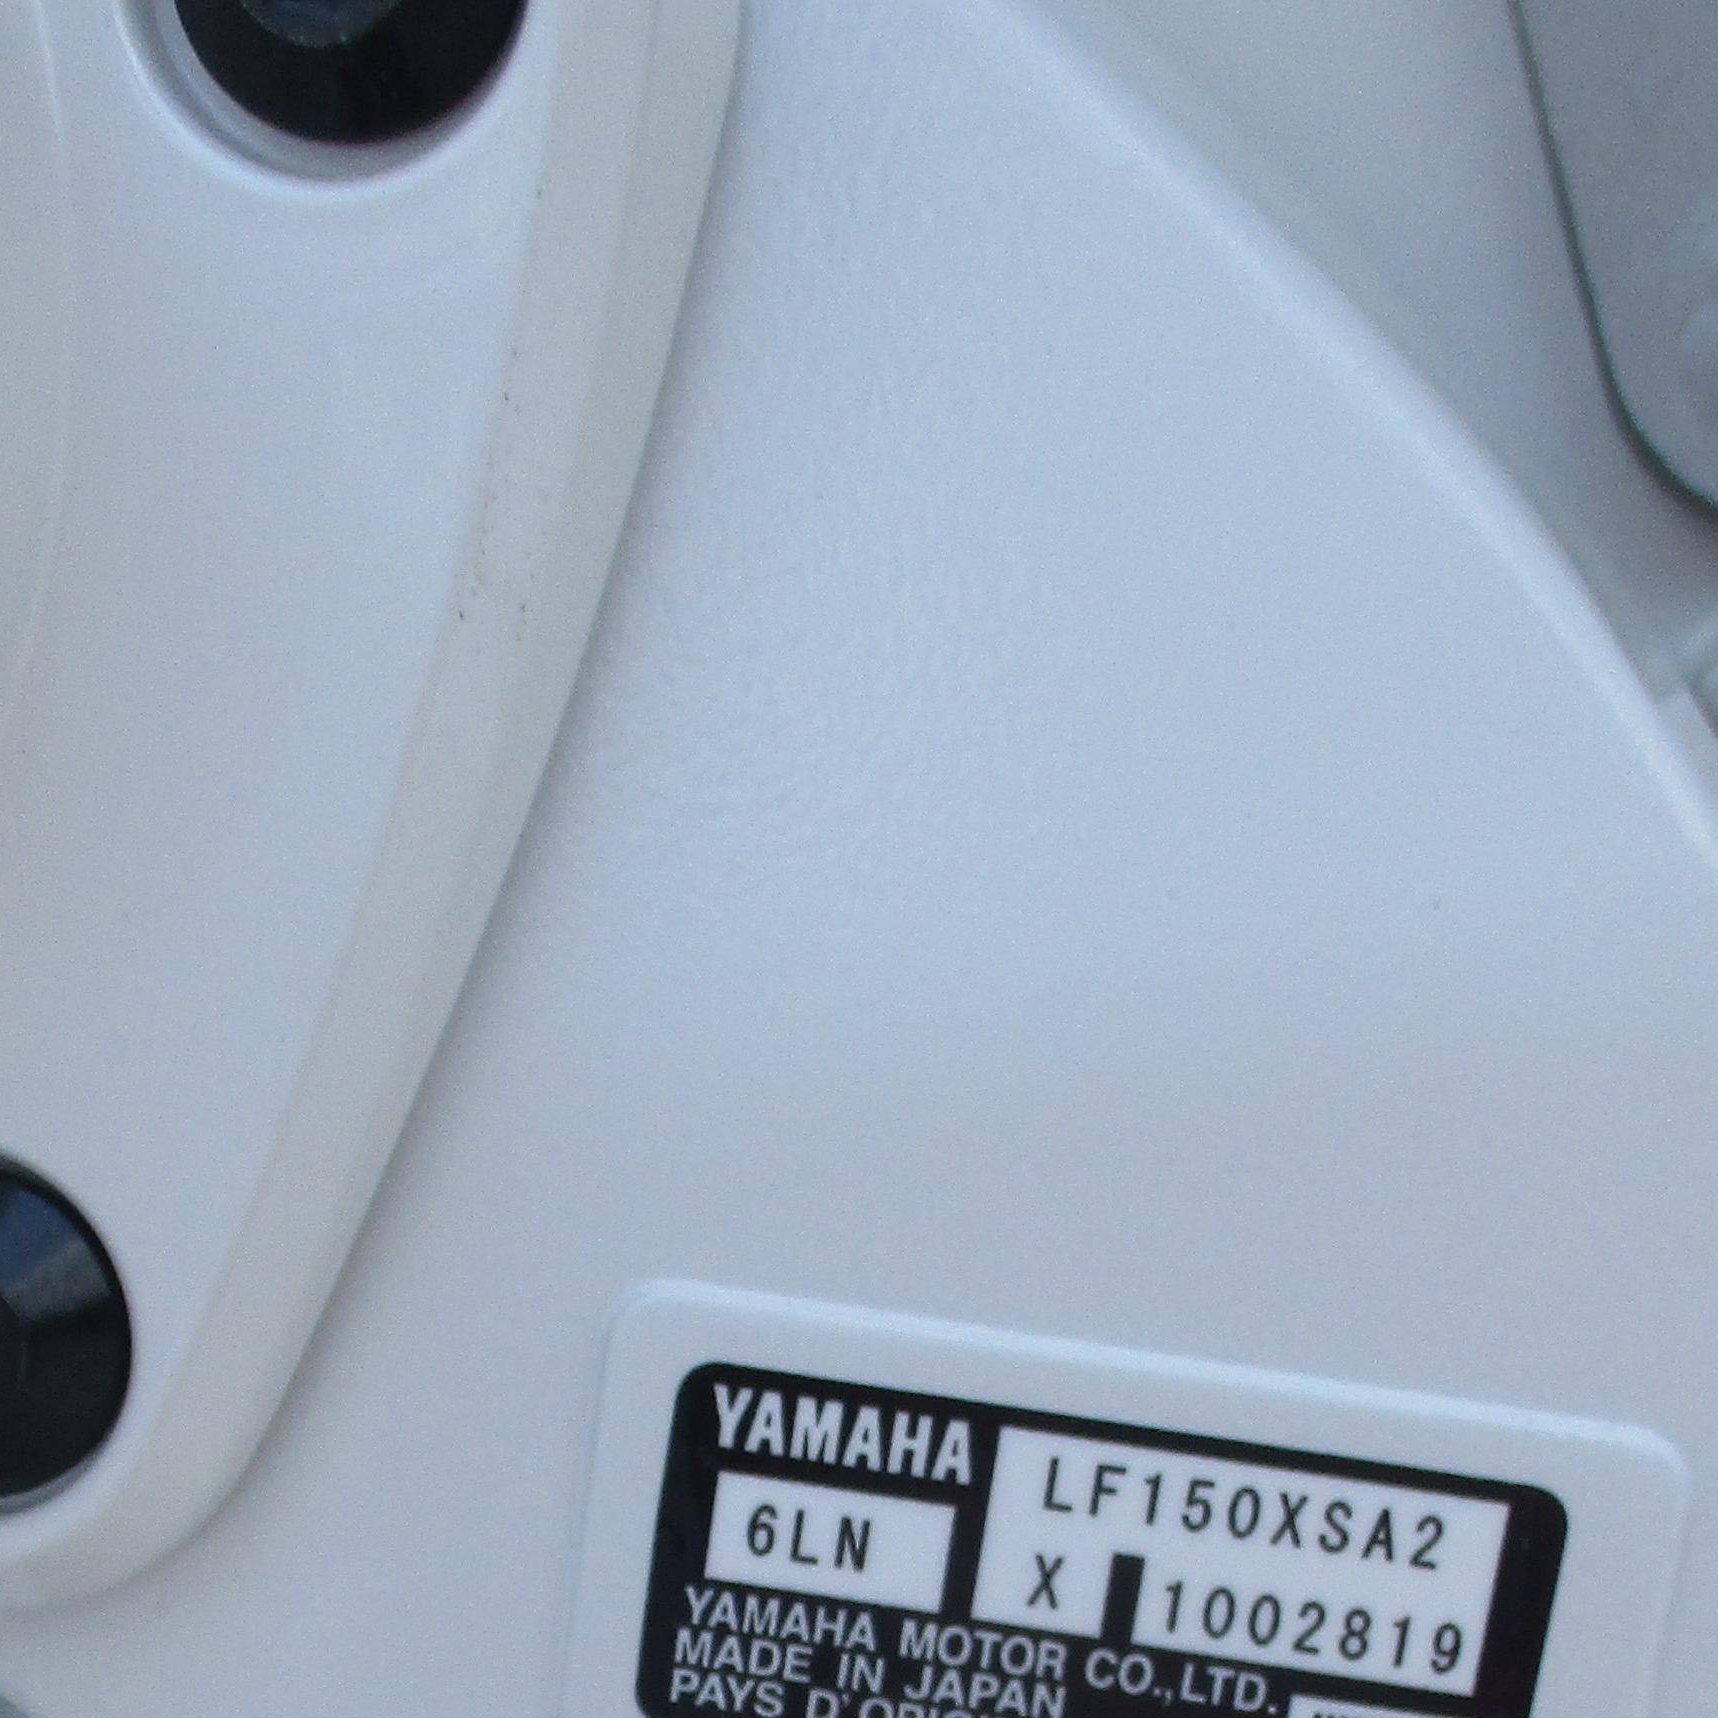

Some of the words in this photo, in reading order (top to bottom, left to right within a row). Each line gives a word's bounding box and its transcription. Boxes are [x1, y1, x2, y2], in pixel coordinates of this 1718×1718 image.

[712, 1384, 973, 1486] YAMAHA
[745, 1504, 871, 1574] 6LN
[1043, 1458, 1446, 1571] LF150XSA2
[683, 1588, 877, 1652] YAMAHA
[897, 1618, 1068, 1679] MOTOR
[1027, 1555, 1062, 1609] X
[1162, 1580, 1464, 1675] 1002819
[675, 1630, 815, 1682] MADE
[837, 1652, 885, 1692] IN
[903, 1664, 1067, 1718] JAPAN
